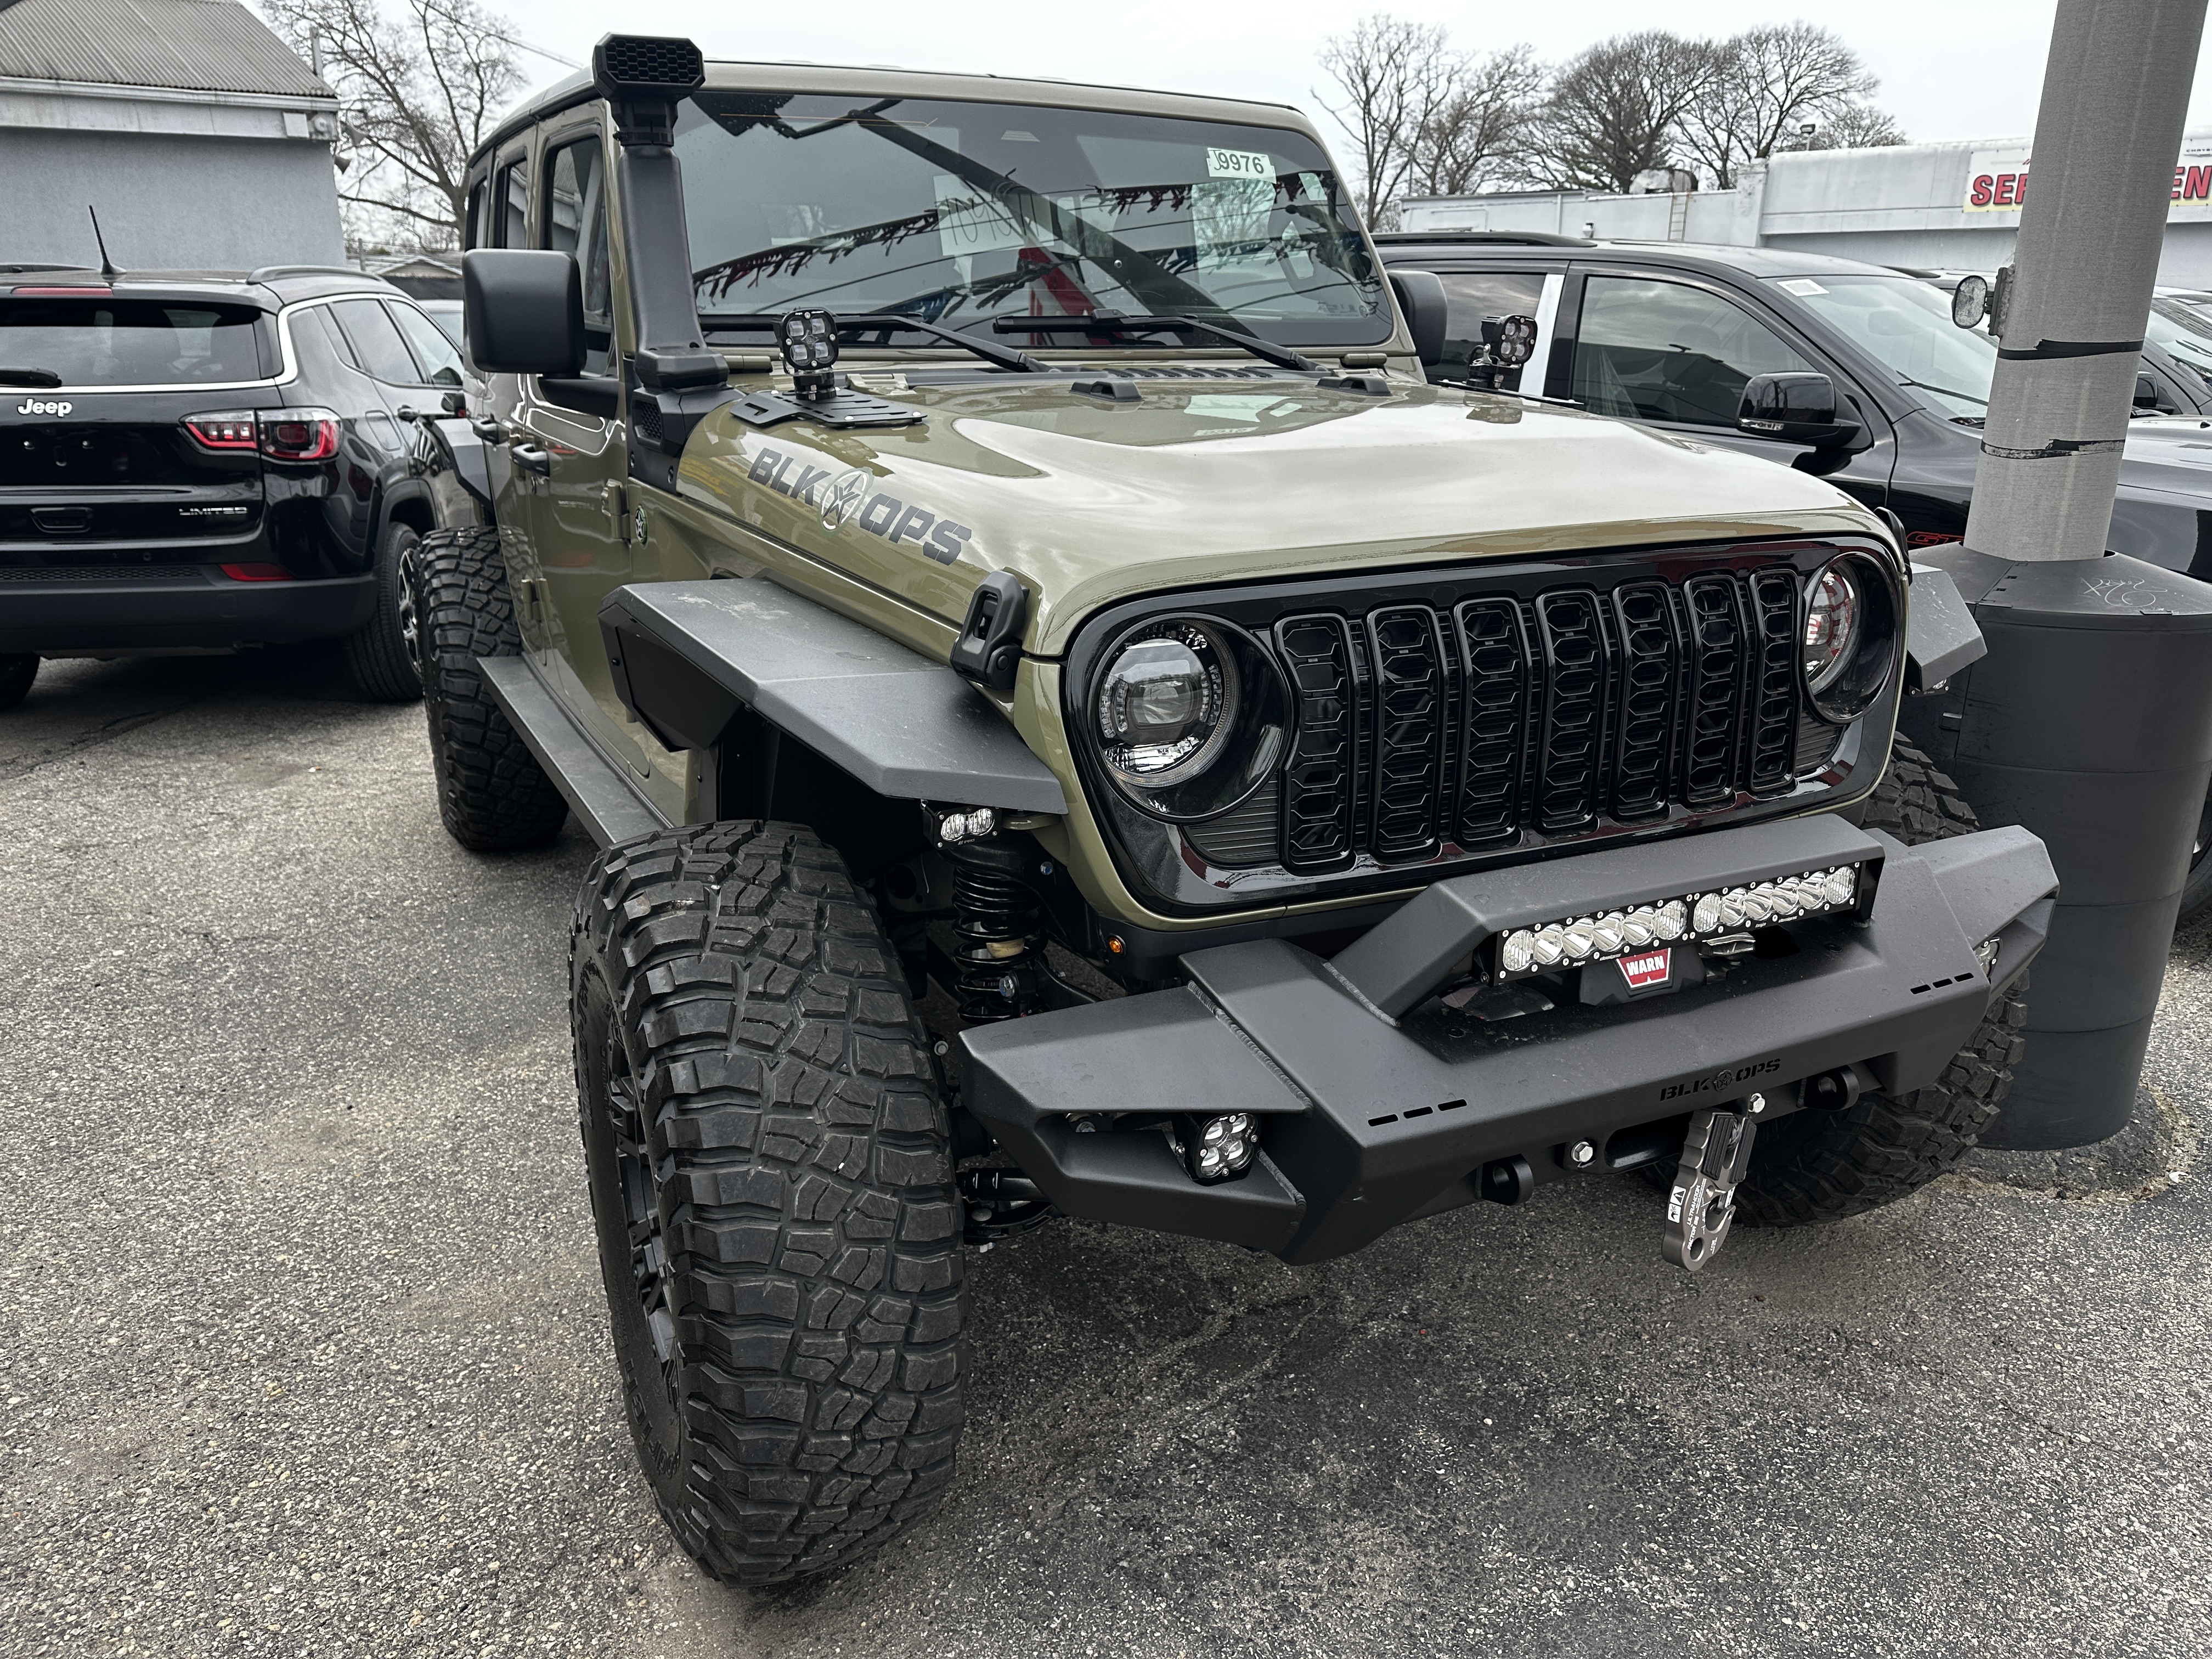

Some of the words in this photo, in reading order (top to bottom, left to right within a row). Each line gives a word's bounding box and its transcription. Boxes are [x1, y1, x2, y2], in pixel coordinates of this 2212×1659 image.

[18, 398, 72, 417] Jeep
[179, 507, 247, 516] LIMITED
[747, 447, 832, 506] BLK
[859, 493, 972, 566] OPS
[1626, 955, 1665, 977] WARN
[1660, 1077, 1710, 1102] BLK
[1736, 1058, 1781, 1082] OPS
